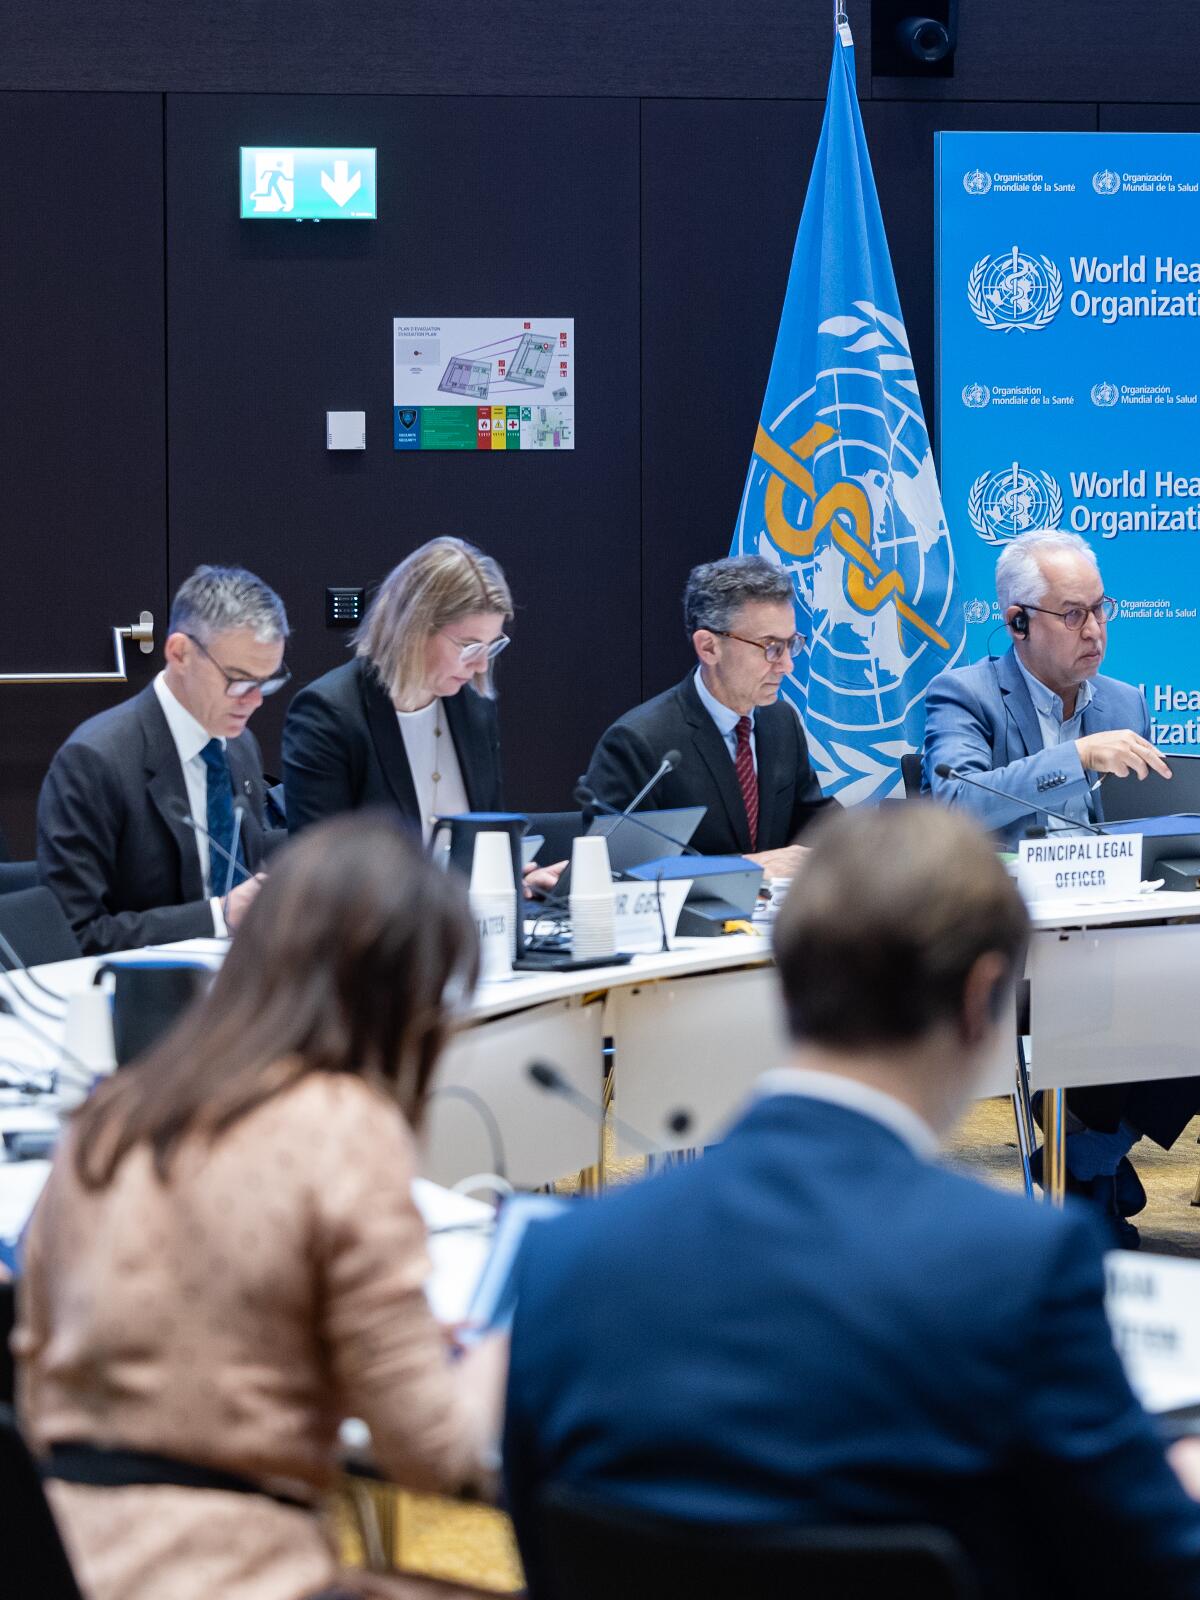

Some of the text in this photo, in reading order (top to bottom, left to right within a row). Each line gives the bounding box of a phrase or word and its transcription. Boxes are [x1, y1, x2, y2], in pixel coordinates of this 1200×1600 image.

[993, 172, 1044, 184] Organisation
[1122, 172, 1173, 184] Organización
[993, 182, 1076, 192] mondiale de la Santé
[1122, 182, 1199, 193] Mundial de la Salud
[1069, 255, 1147, 283] World
[991, 385, 1043, 397] Organisation
[1120, 384, 1171, 396] Organización
[991, 395, 1075, 405] mondiale de la Santé
[1120, 394, 1198, 404] Mundial de la Salud
[1069, 469, 1147, 498] World
[1119, 599, 1171, 610] Organización
[1119, 608, 1197, 618] Mundial de la Salud
[1027, 840, 1134, 863] PRINCIPAL LEGAL
[1055, 869, 1106, 889] OFFICER
